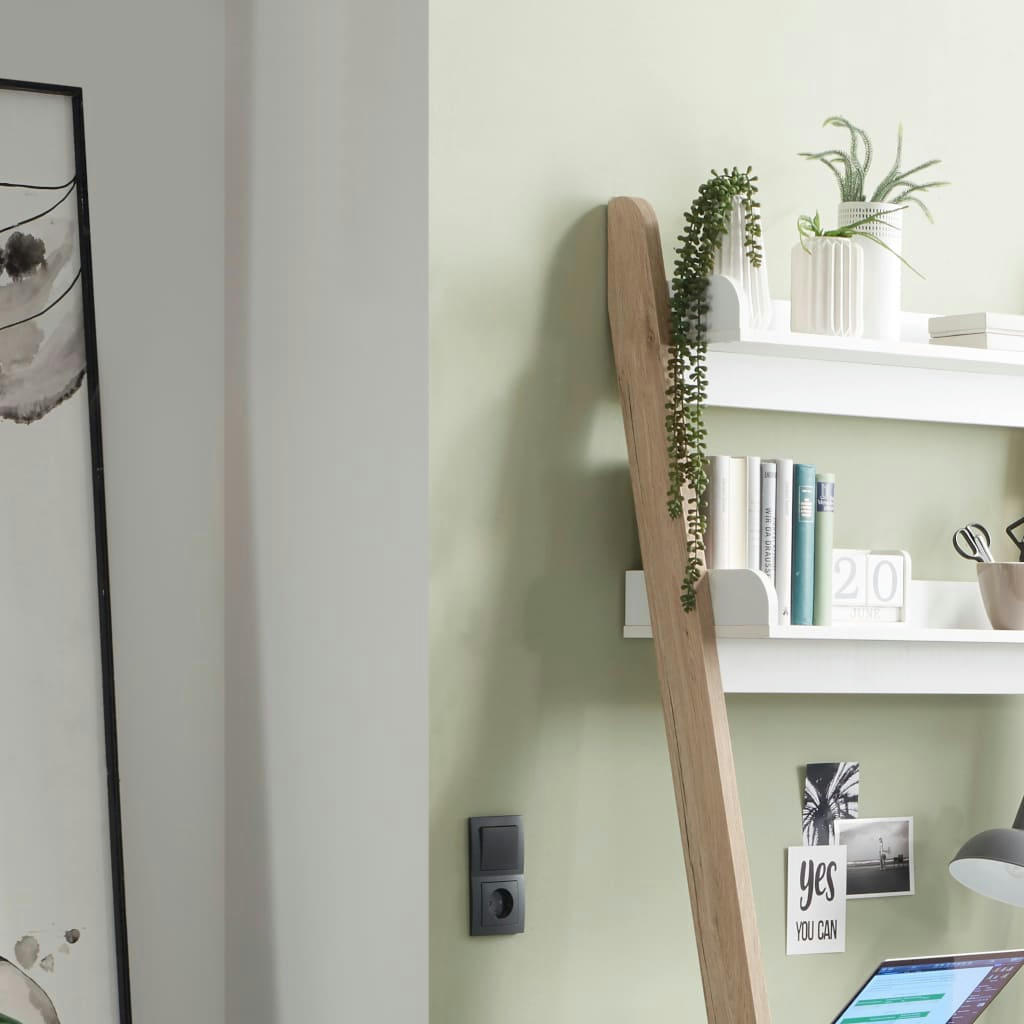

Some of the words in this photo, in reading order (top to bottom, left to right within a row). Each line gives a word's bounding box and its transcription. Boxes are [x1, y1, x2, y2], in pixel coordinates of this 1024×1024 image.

[764, 507, 772, 523] WIR
[764, 526, 772, 538] DA
[834, 556, 898, 602] 20
[849, 607, 881, 618] JUNE
[800, 859, 837, 911] yes
[796, 920, 814, 942] YOU
[817, 919, 838, 941] CAN
